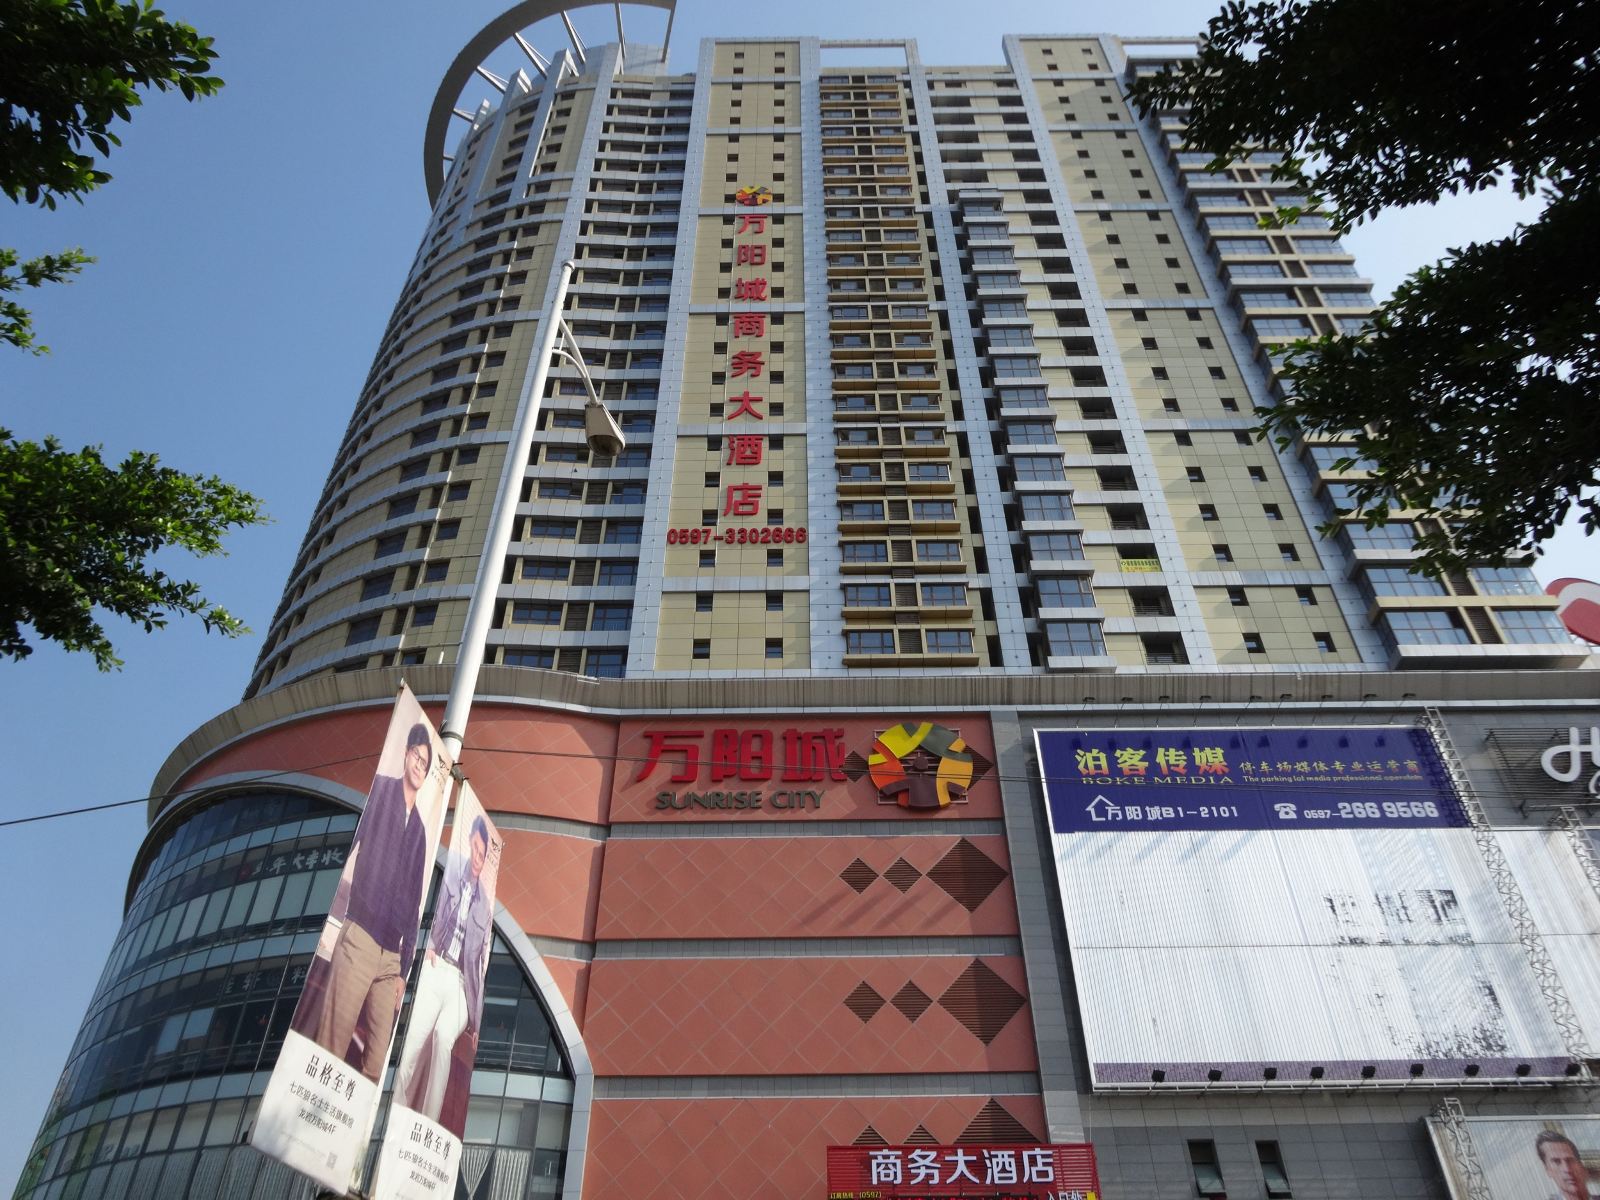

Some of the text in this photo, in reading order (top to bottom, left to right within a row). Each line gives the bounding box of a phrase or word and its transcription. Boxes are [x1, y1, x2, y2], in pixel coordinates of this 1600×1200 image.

[723, 214, 769, 516] 万阳城商务大酒店
[636, 729, 847, 782] 万阳城
[1075, 747, 1230, 775] 泊客传媒
[1082, 776, 1234, 785] BOKE MEDIA
[655, 790, 825, 810] SUNRISE CITY
[305, 1054, 356, 1101] 品格至尊
[410, 1121, 451, 1160] 品格至尊
[869, 1147, 1055, 1185] 商务大酒店
